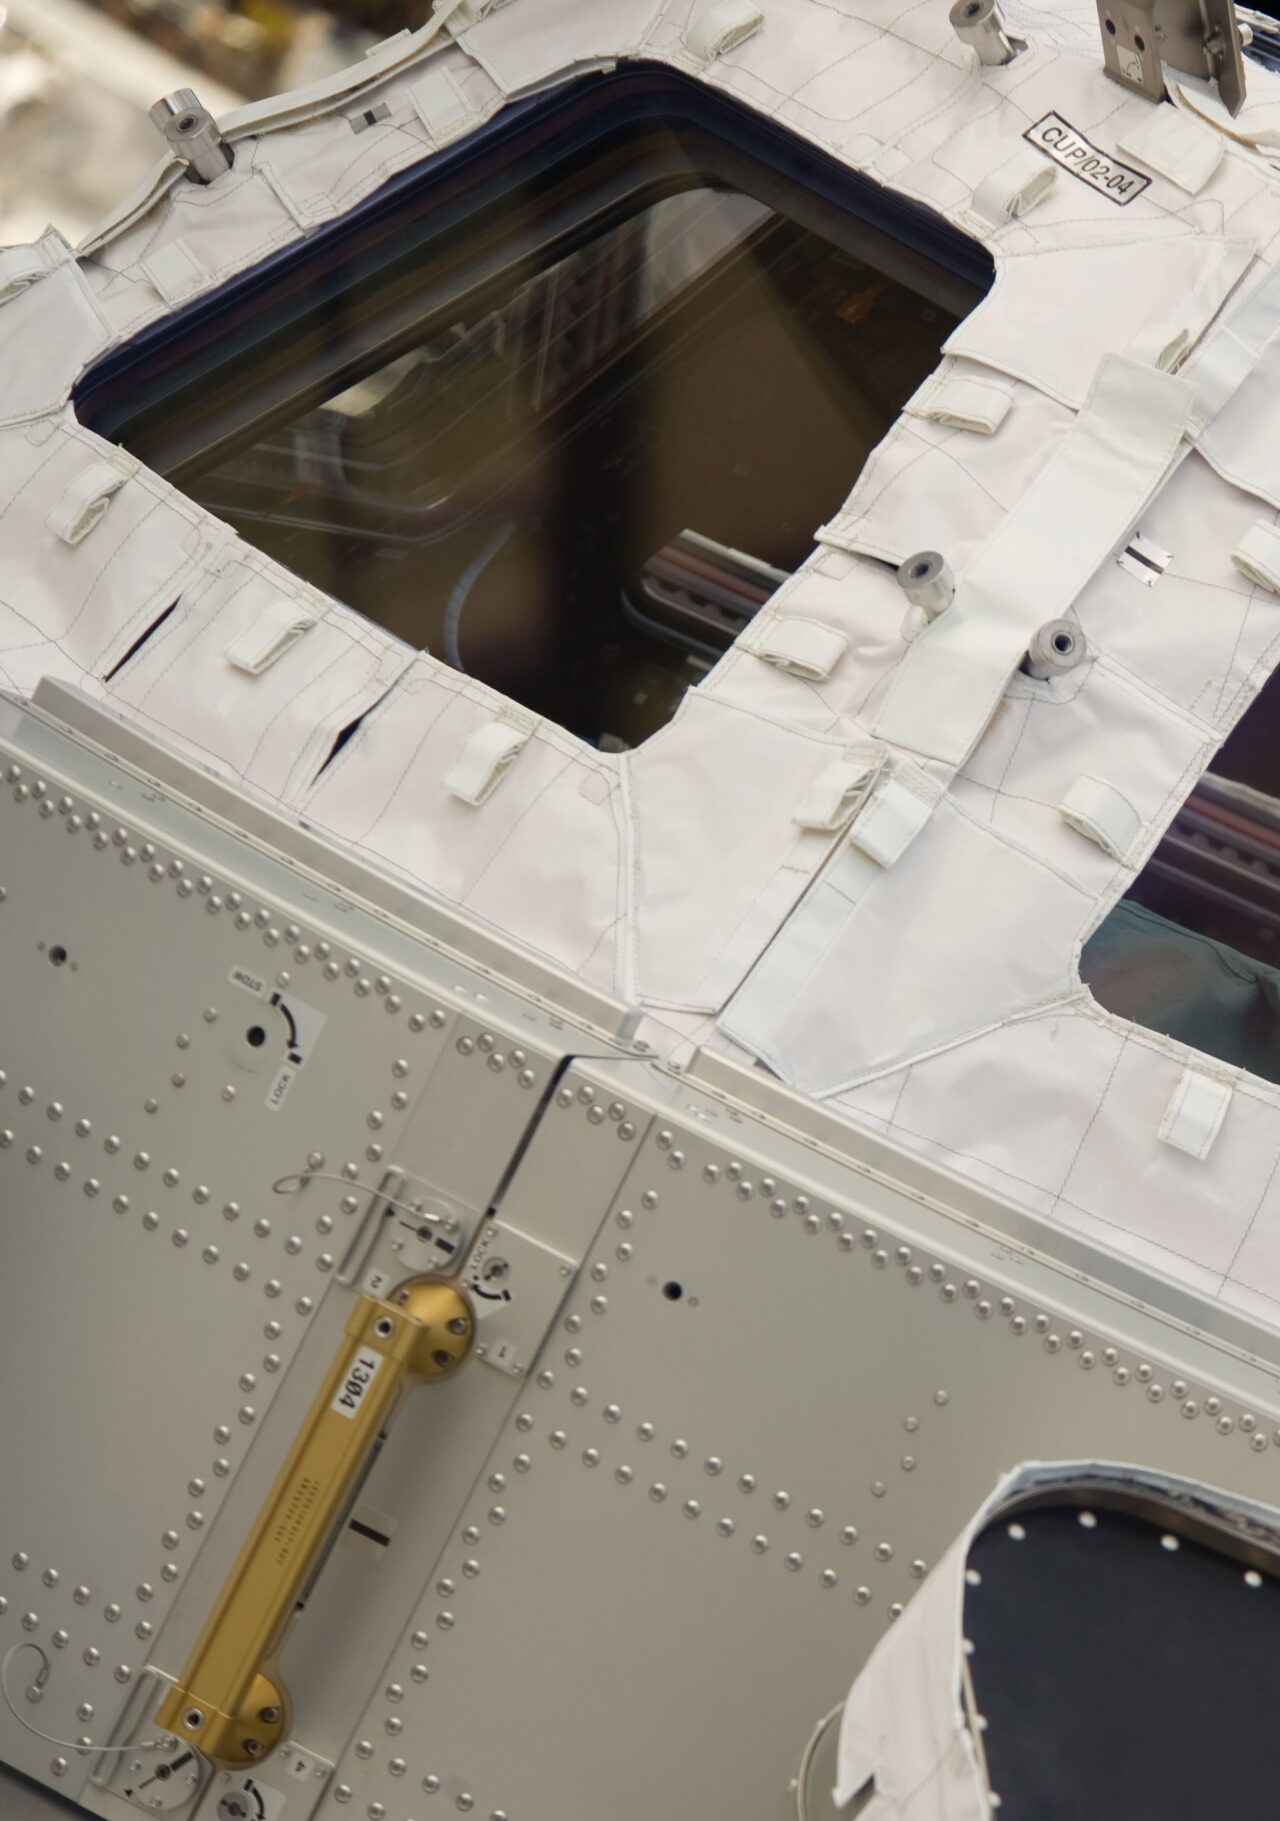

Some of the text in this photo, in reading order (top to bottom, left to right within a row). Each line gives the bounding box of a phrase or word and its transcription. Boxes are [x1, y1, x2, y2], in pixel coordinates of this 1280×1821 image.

[1041, 126, 1135, 195] CUP/02-04
[270, 1073, 291, 1105] LOCK
[470, 1239, 489, 1270] LOCK
[339, 1358, 376, 1409] 1304
